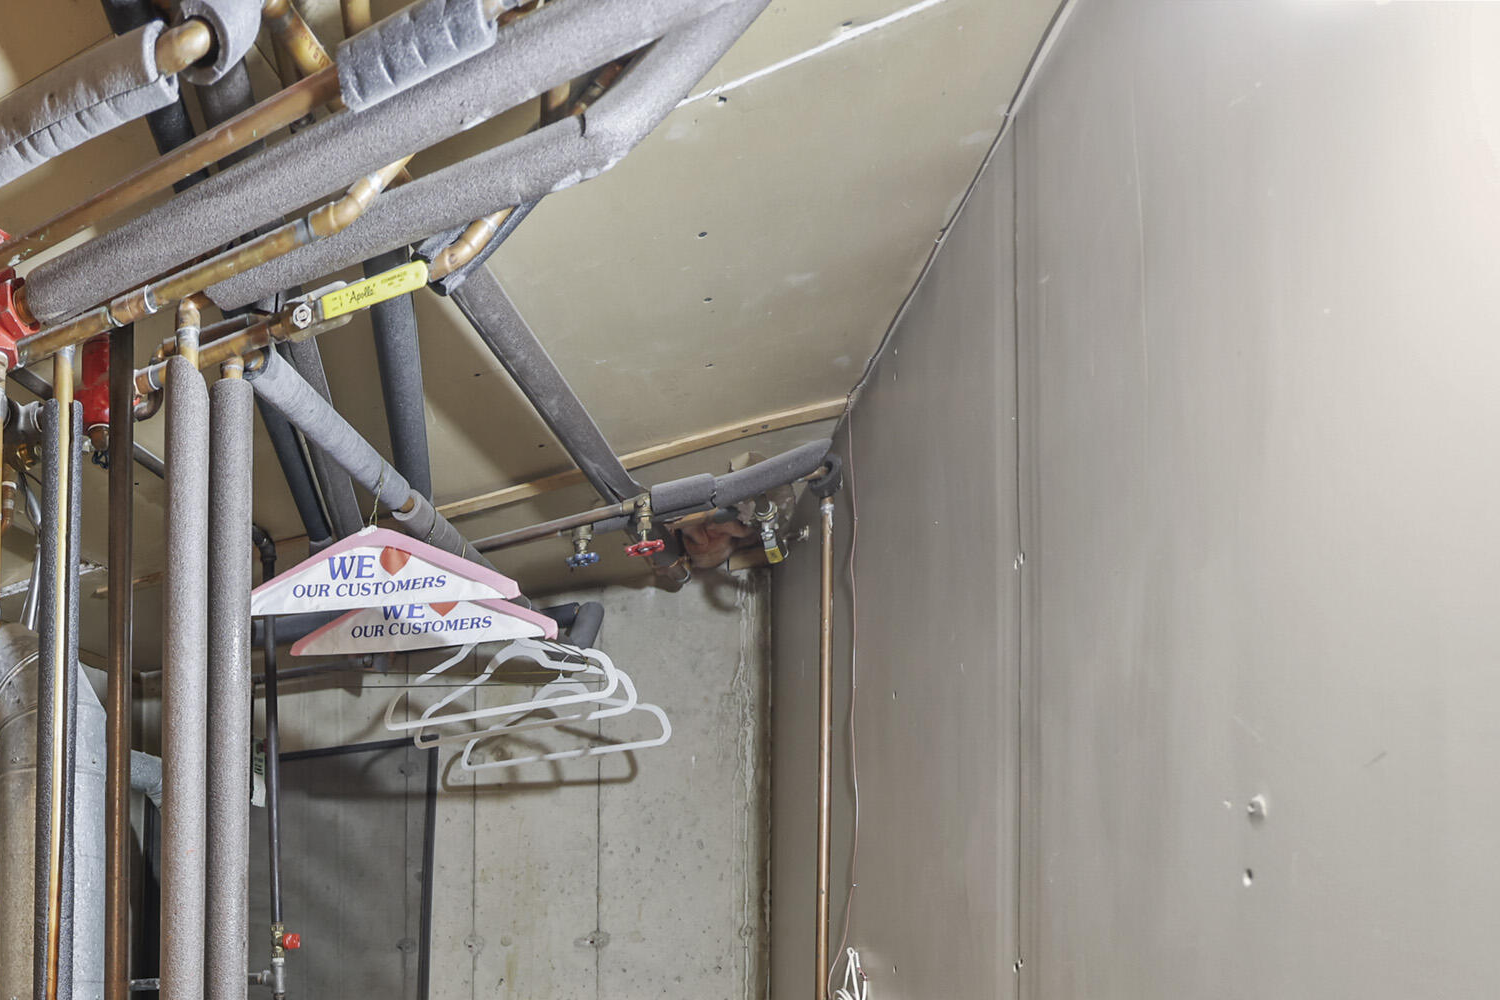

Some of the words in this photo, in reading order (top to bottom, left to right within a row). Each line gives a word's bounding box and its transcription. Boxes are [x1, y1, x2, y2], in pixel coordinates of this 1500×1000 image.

[327, 555, 376, 580] WE
[292, 584, 329, 599] OUR
[335, 575, 447, 598] CUSTOMERS
[382, 602, 426, 621] WE
[350, 625, 384, 639] OUR
[388, 616, 492, 637] CUSTOMERS
